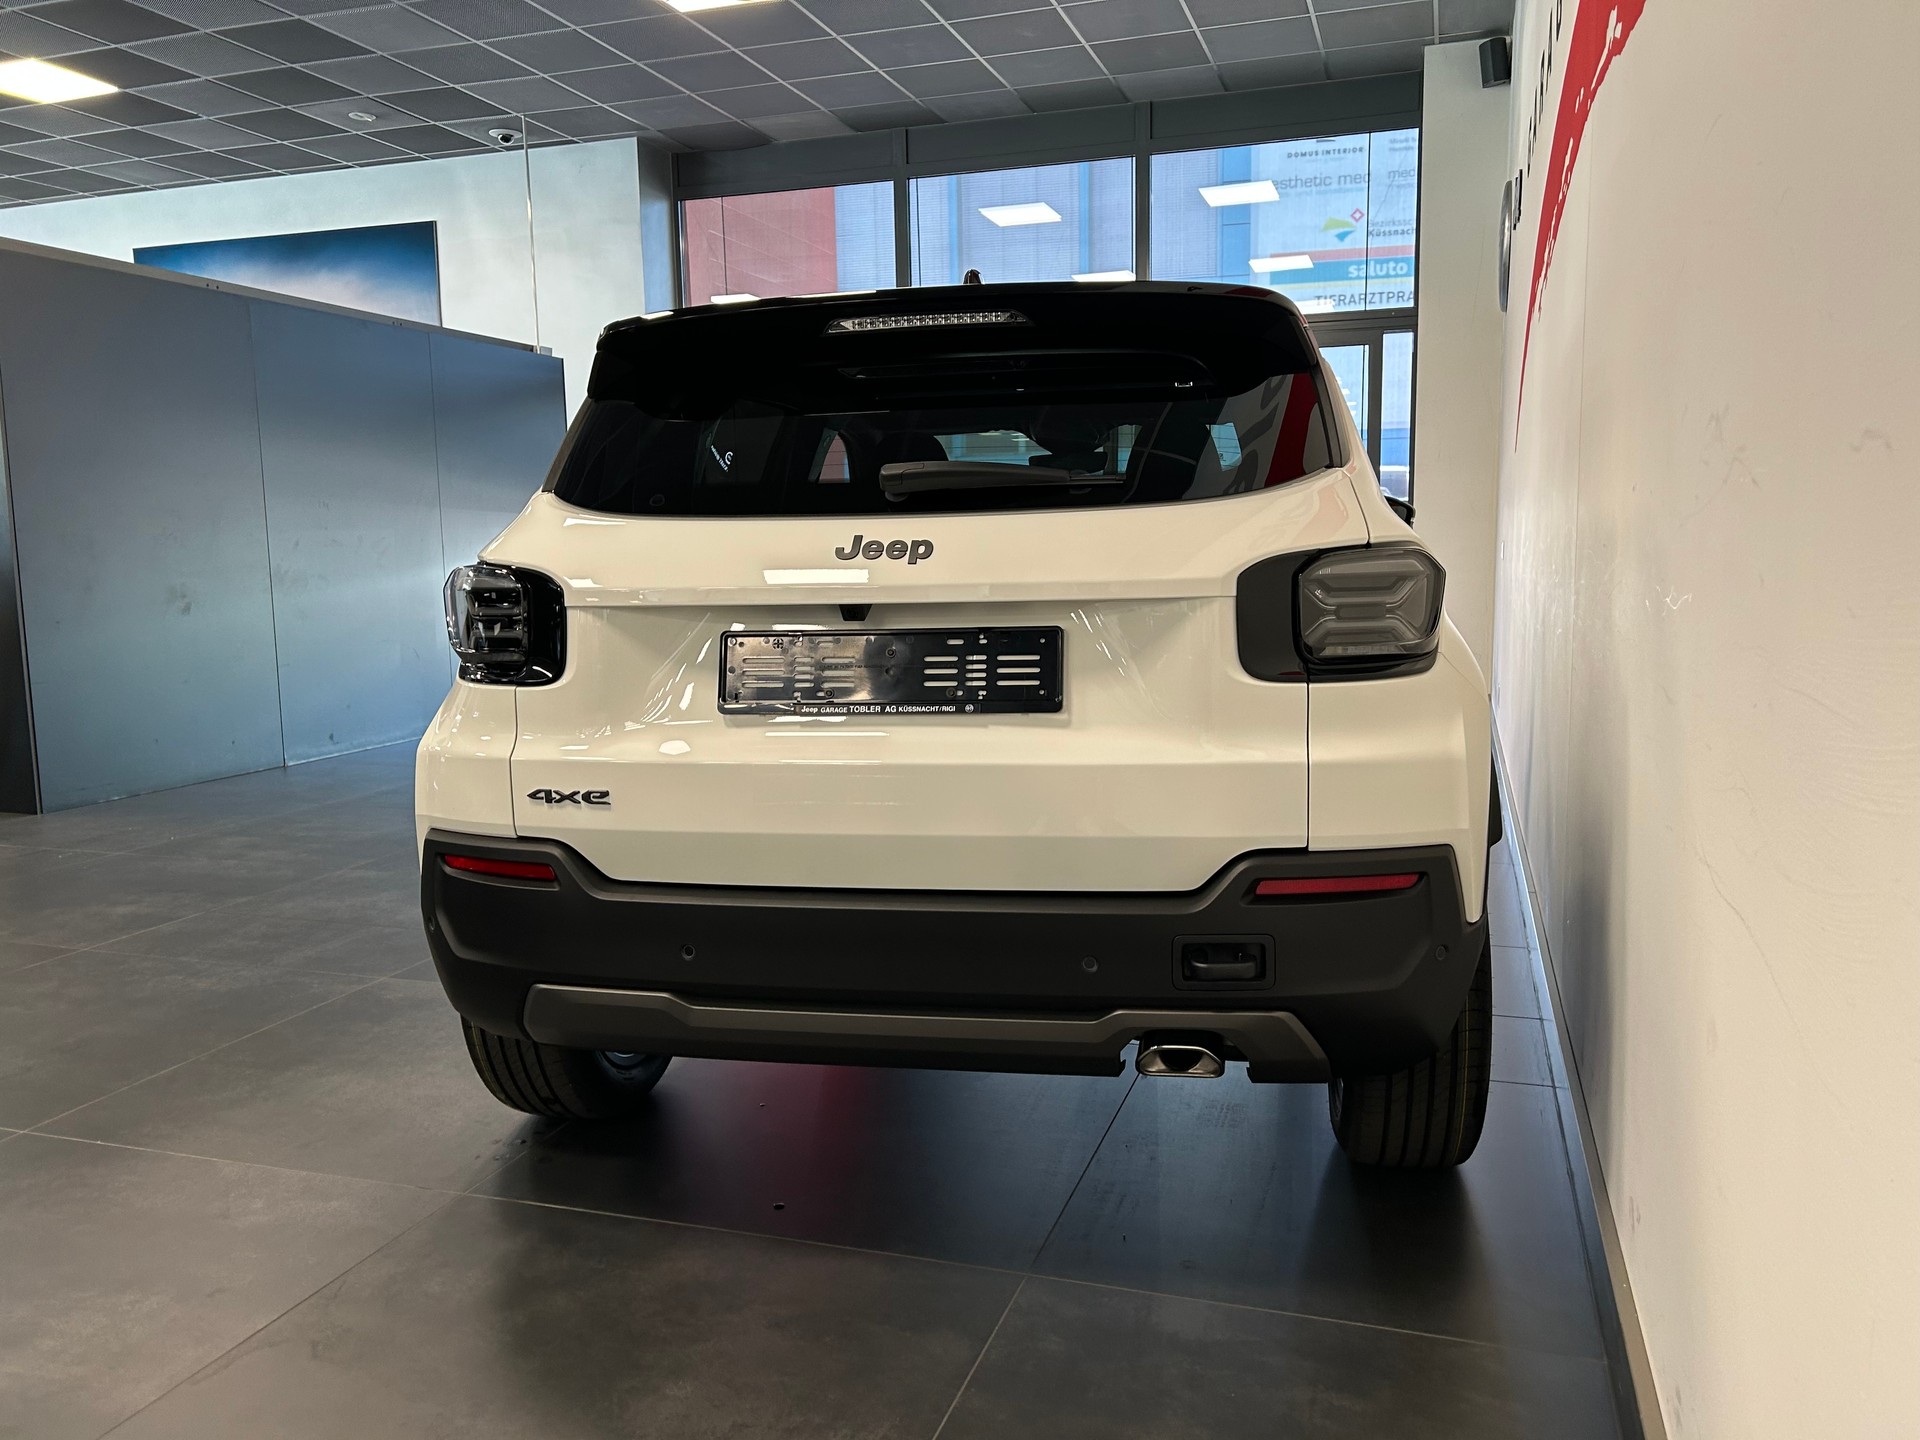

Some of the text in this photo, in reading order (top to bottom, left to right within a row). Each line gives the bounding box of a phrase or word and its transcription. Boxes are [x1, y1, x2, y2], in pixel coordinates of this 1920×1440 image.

[1287, 146, 1364, 159] DOMUS INTERIOR
[1347, 260, 1408, 278] saluto
[834, 534, 934, 565] Jeep
[801, 705, 818, 713] Jeep
[849, 705, 881, 713] TOBLER
[884, 705, 897, 713] AG
[898, 704, 956, 713] KÜSSNACHT/RIGI
